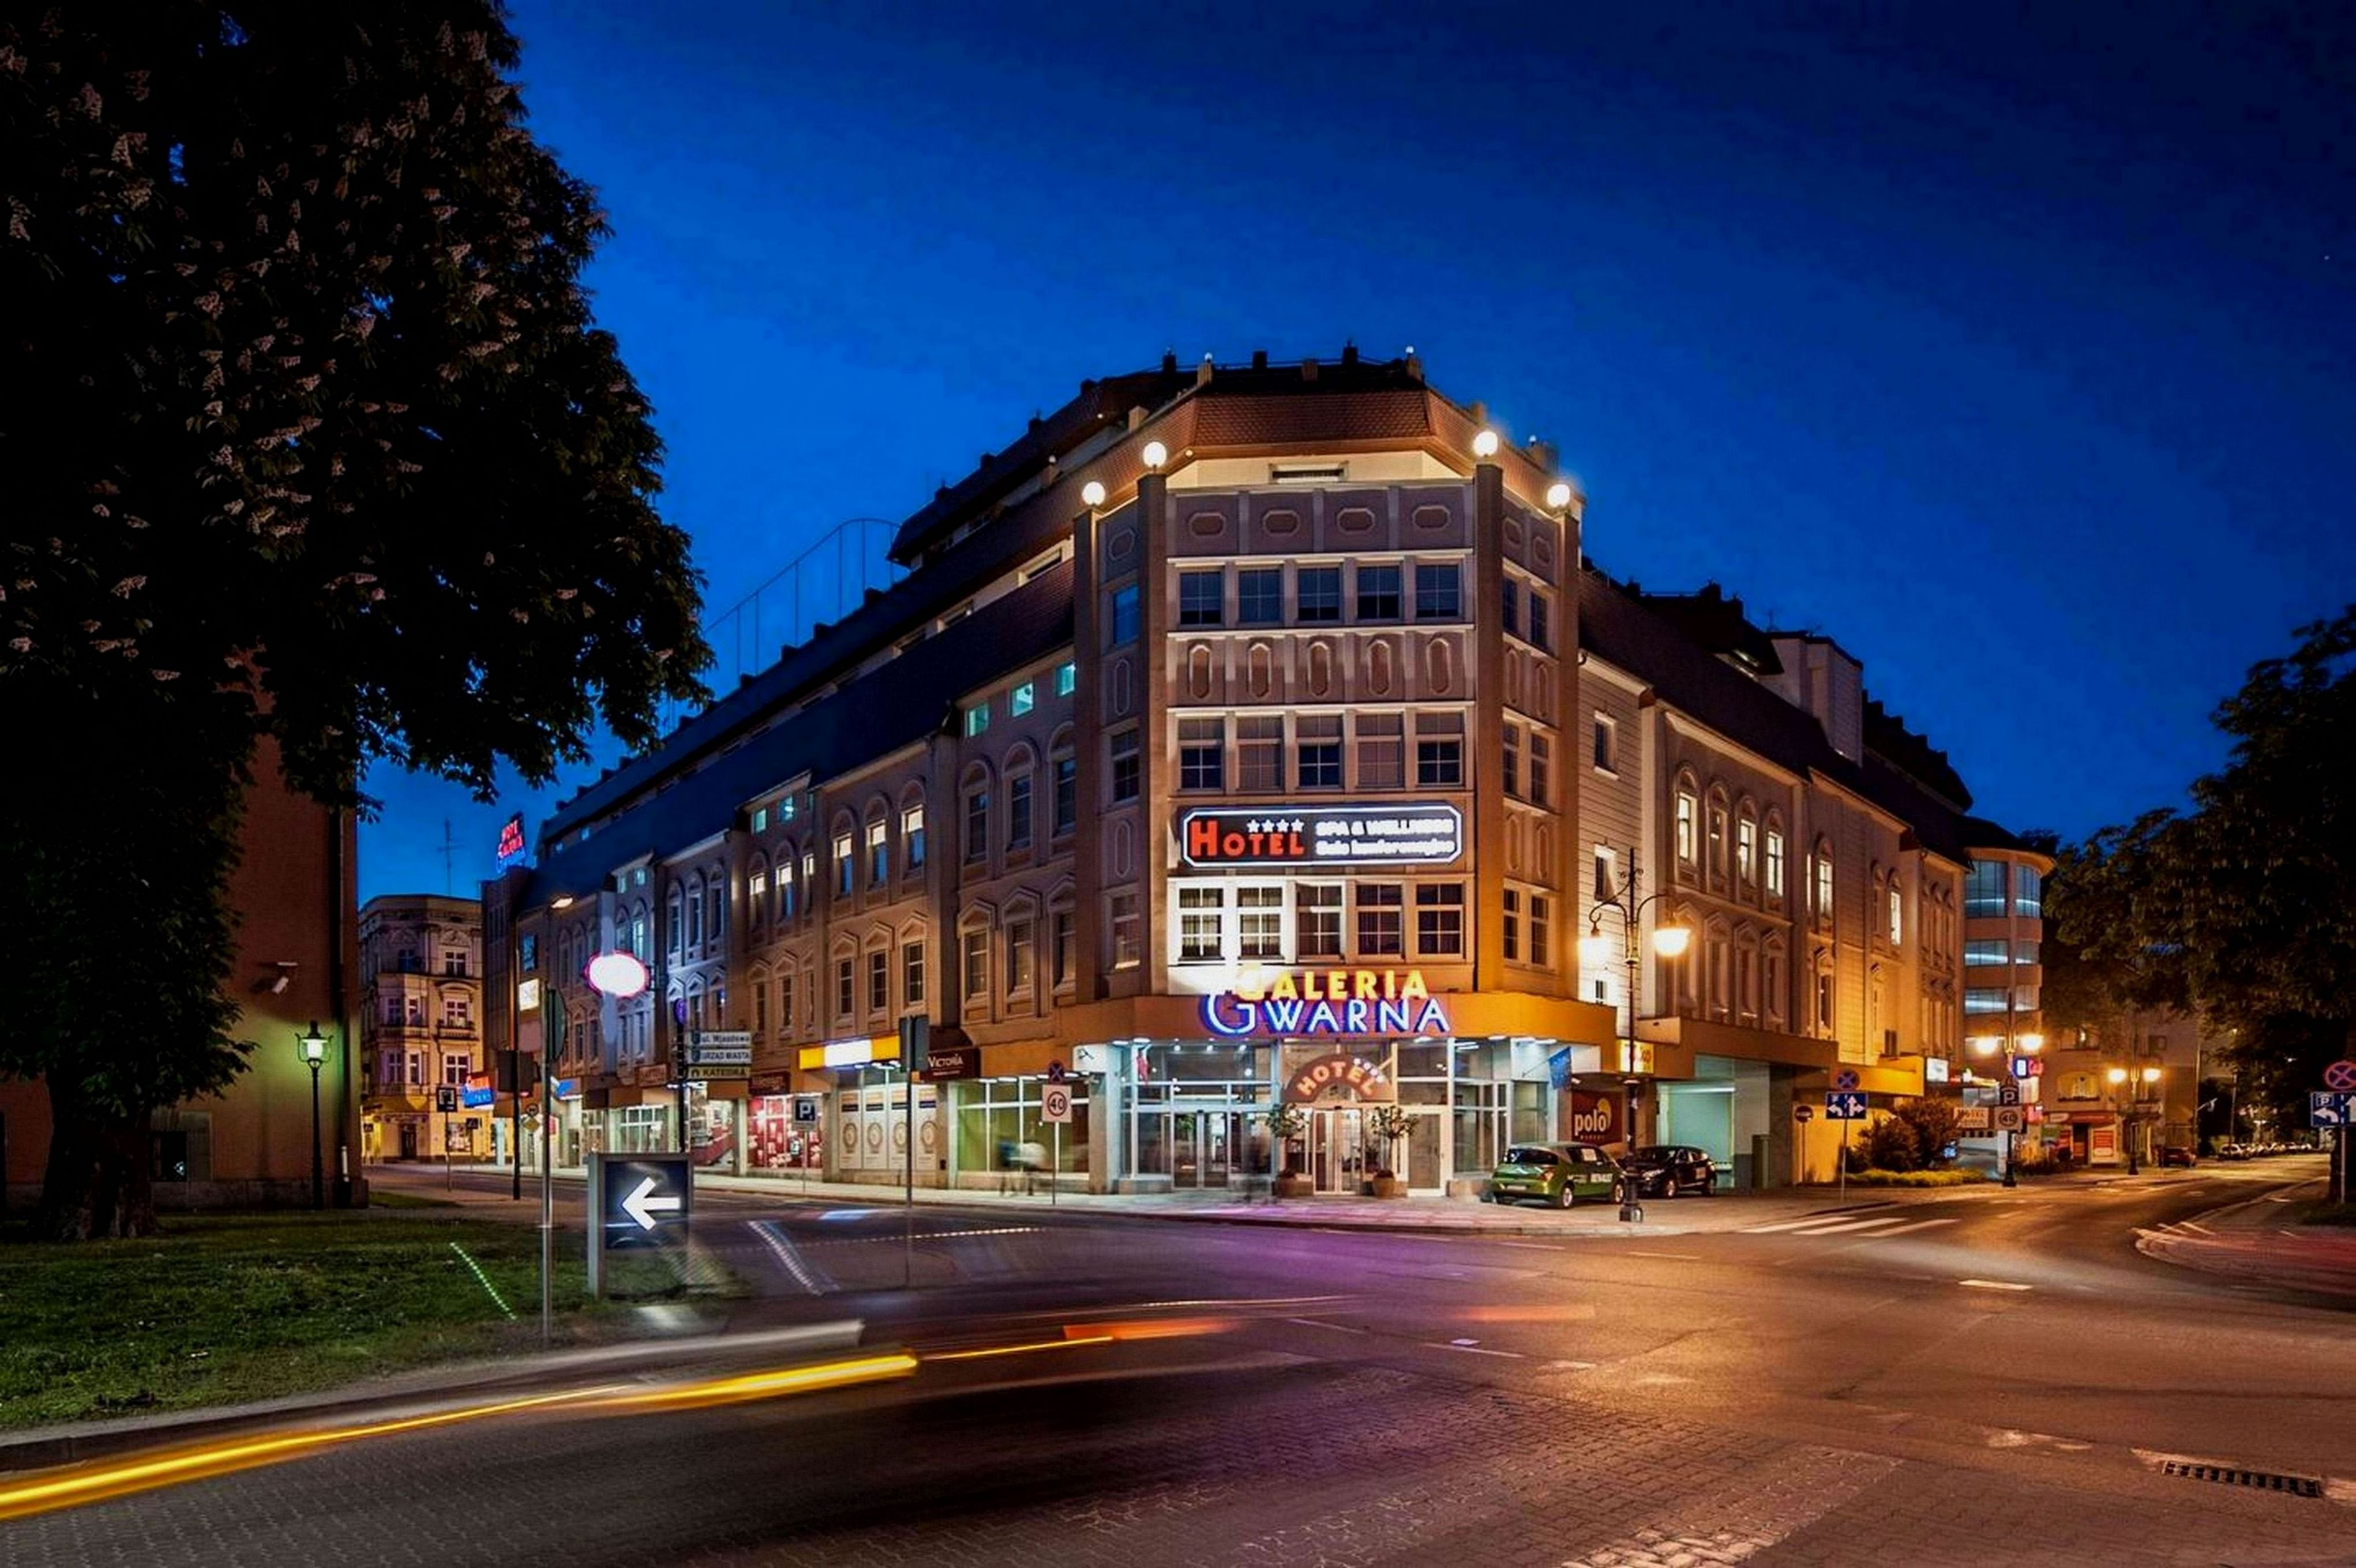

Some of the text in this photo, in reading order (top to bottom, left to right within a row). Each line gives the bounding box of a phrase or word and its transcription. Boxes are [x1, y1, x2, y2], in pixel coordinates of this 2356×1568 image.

[1189, 820, 1304, 857] HOTEL
[1236, 966, 1430, 1001] GALERIA
[1202, 989, 1451, 1036] GWARNA
[1297, 1061, 1376, 1096] HOTEL
[799, 1102, 811, 1119] P
[1050, 1098, 1064, 1110] 40
[1574, 1109, 1607, 1136] polo
